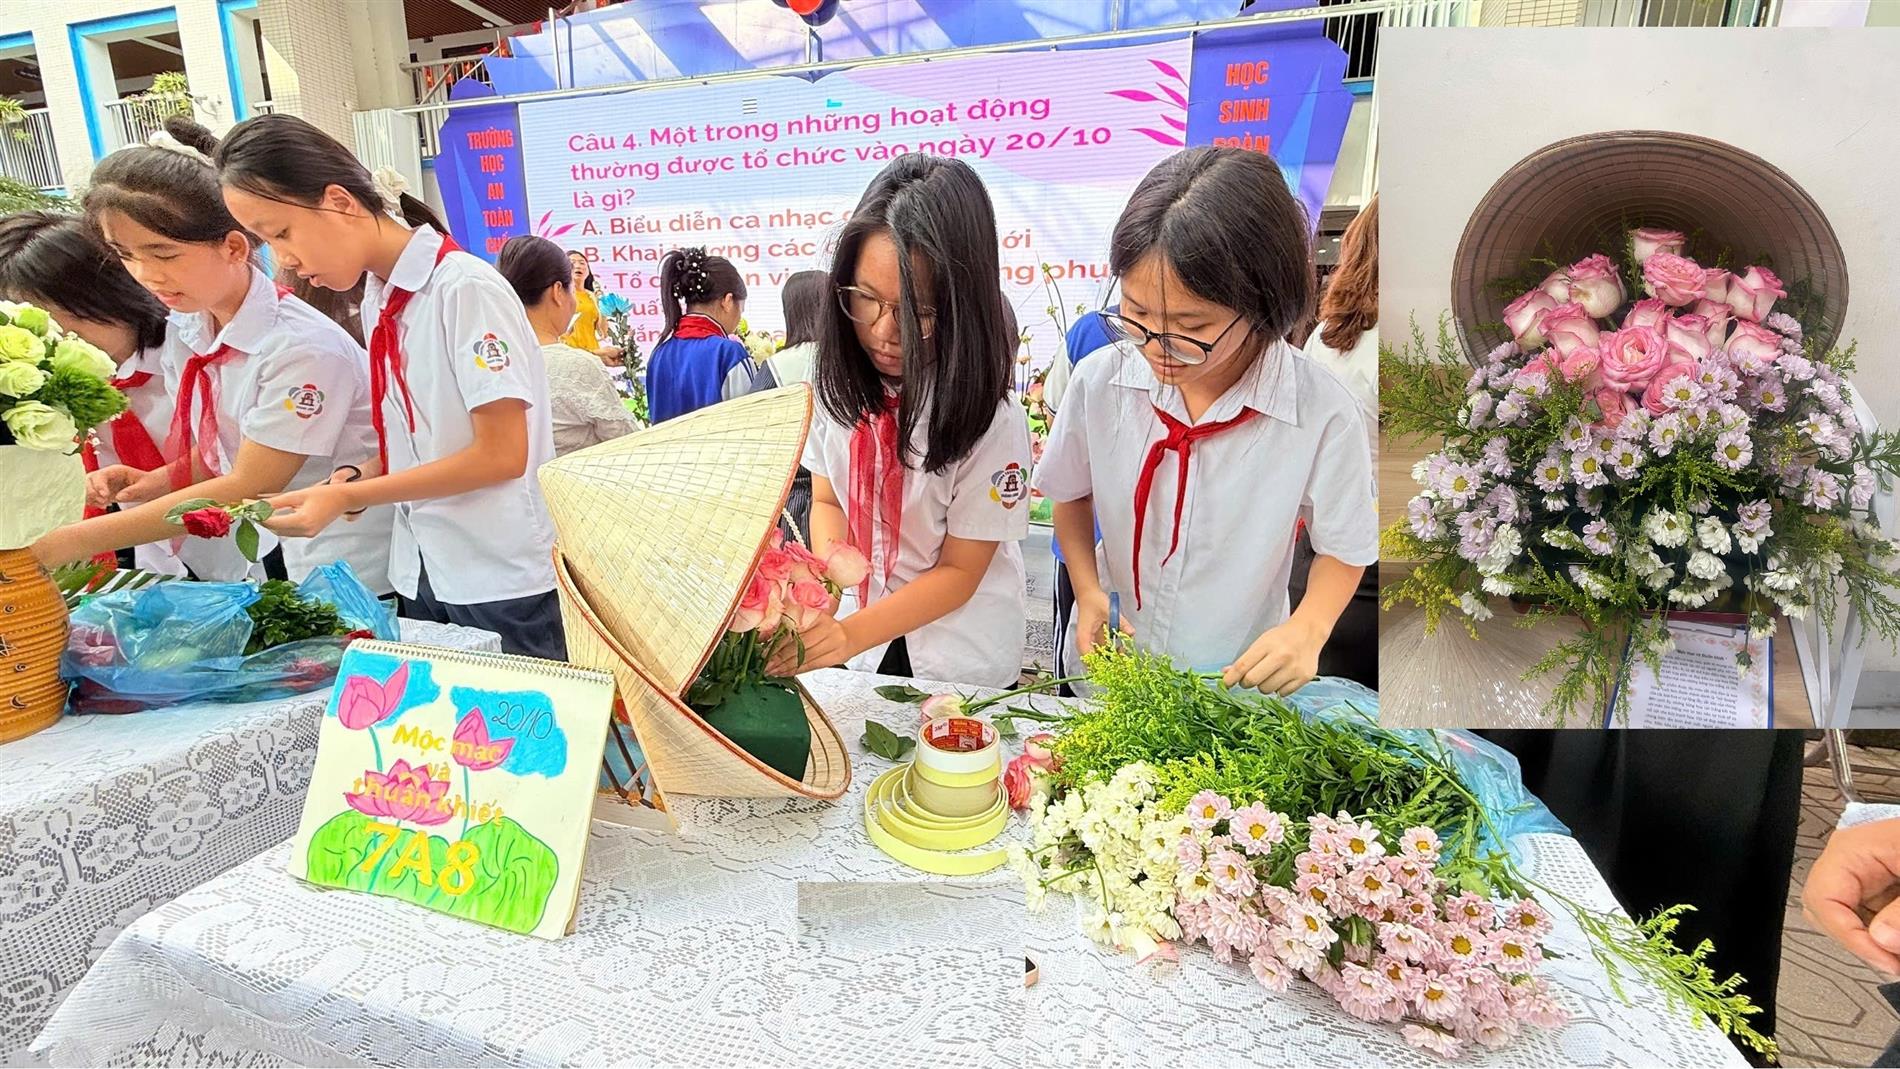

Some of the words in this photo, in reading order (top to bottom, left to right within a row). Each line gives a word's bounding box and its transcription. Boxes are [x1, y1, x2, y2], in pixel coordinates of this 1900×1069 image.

[1225, 60, 1269, 90] HỌC
[1219, 98, 1270, 124] SINH
[467, 126, 514, 149] TRƯỜNG
[568, 133, 616, 152] Câu
[622, 133, 642, 150] 4.
[650, 125, 698, 147] Một
[705, 124, 778, 142] trong
[787, 113, 880, 135] những
[890, 103, 958, 127] hoạt
[967, 98, 1051, 122] động
[480, 154, 505, 175] HỌC
[571, 161, 660, 181] thường
[667, 156, 735, 175] được
[742, 148, 768, 169] tổ
[776, 146, 847, 166] chức
[855, 140, 909, 160] vào
[918, 134, 996, 158] ngày
[1006, 126, 1112, 151] 20/10
[487, 182, 505, 200] AN
[573, 191, 595, 208] là
[601, 188, 636, 211] gì?
[482, 207, 514, 227] TOÀN
[582, 219, 603, 236] A.
[610, 214, 661, 235] Biểu
[668, 211, 721, 232] diễn
[729, 214, 760, 229] ca
[769, 208, 833, 230] nhạc
[584, 246, 605, 263] B.
[612, 244, 663, 262] Khai
[768, 238, 817, 257] các
[613, 272, 642, 289] Tổ
[492, 701, 554, 740] 20/10
[392, 724, 446, 756] Mộc
[427, 761, 451, 781] và
[435, 790, 504, 827] khiết
[361, 822, 481, 896] 7A8
